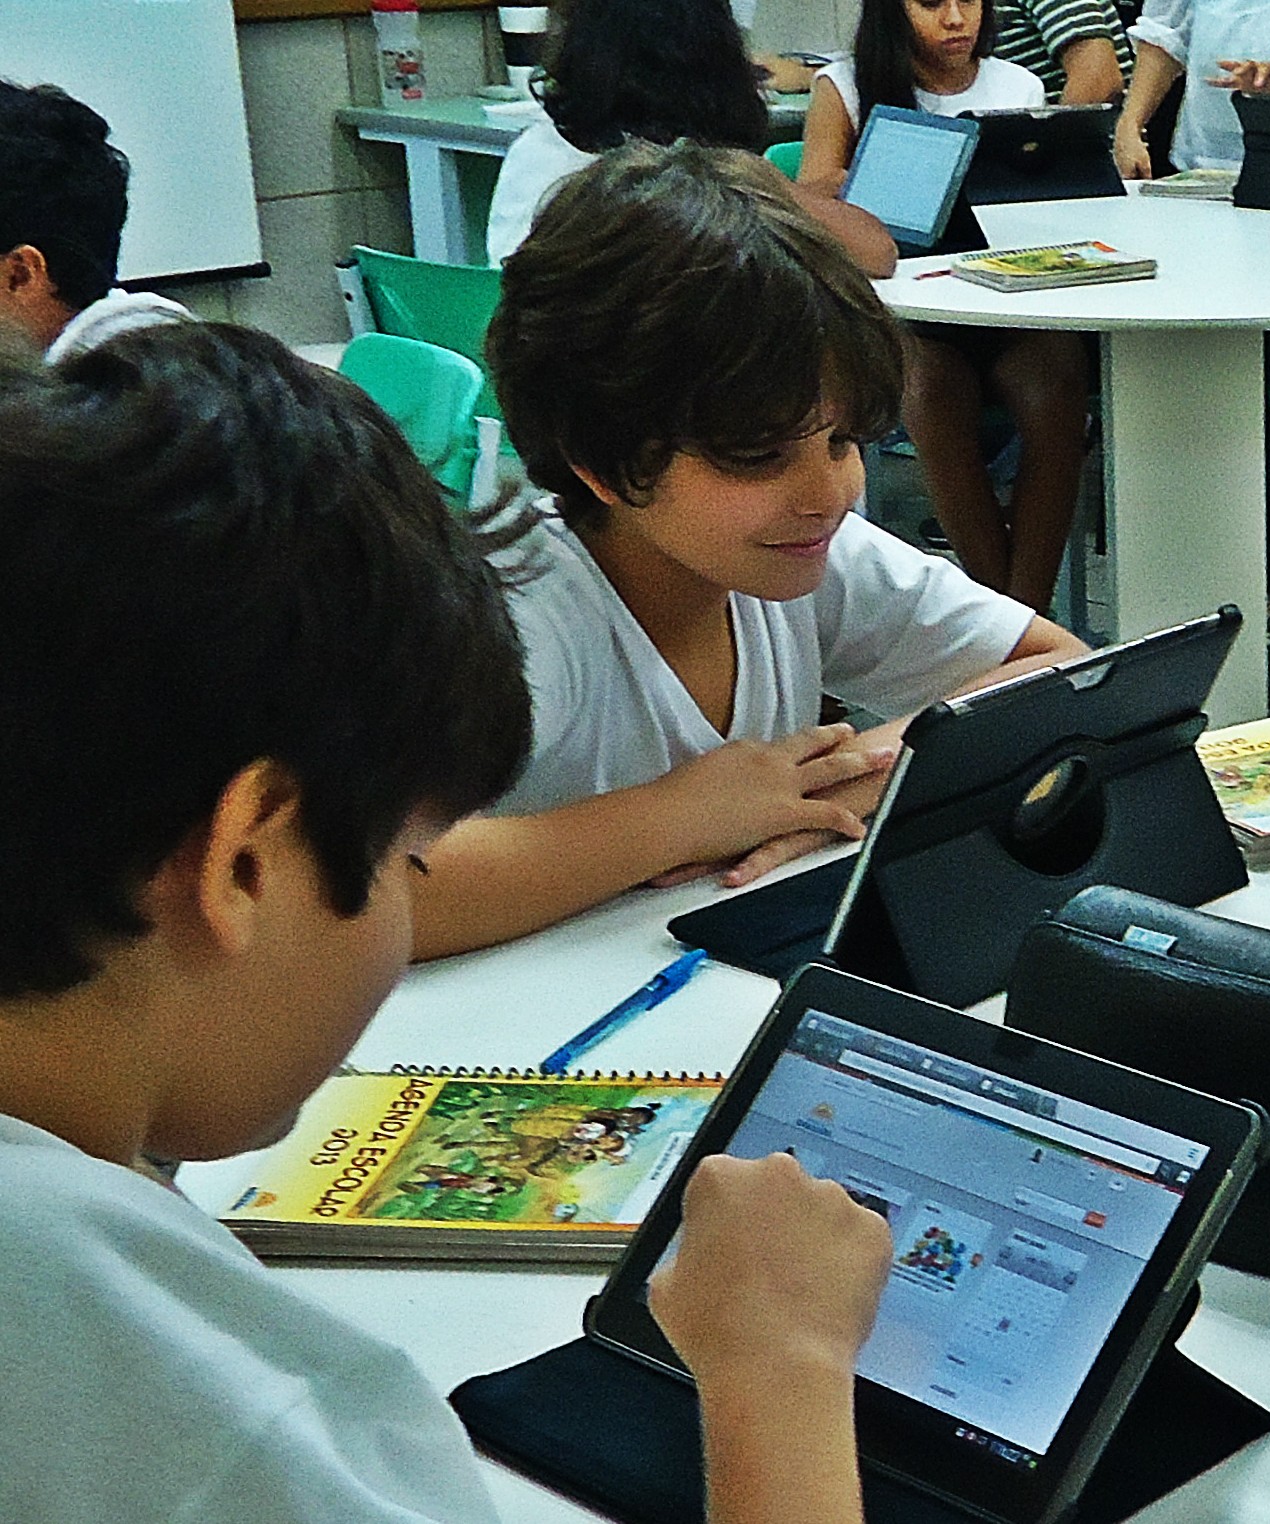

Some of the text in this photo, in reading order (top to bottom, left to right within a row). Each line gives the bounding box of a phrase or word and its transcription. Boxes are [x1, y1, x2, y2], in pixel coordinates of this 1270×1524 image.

[309, 1127, 359, 1166] 2013
[311, 1078, 434, 1217] AGENDA ESCOLAR
